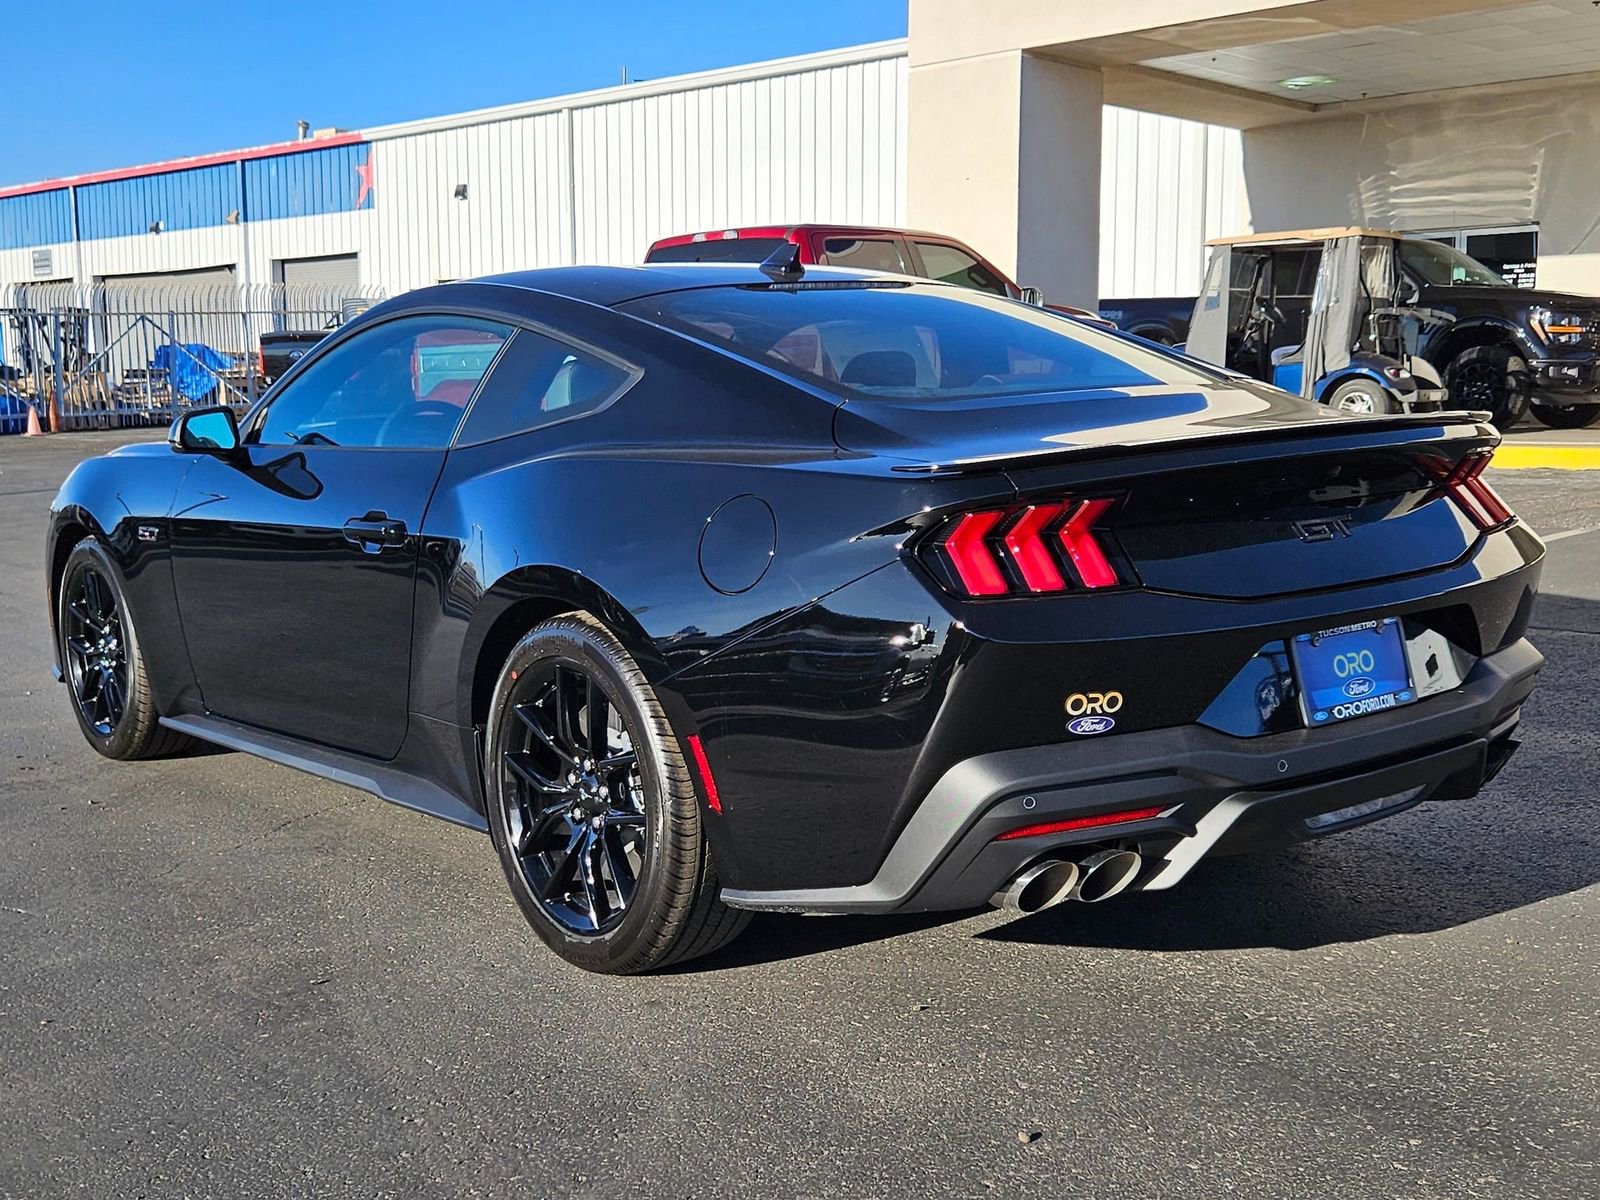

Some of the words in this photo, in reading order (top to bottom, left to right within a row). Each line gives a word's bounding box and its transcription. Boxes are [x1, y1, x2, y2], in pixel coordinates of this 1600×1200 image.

[1291, 514, 1352, 541] GT
[1318, 626, 1350, 638] TUCSON
[1350, 620, 1377, 632] METRO
[1333, 649, 1375, 678] ORO
[1348, 679, 1370, 695] Ford
[1065, 691, 1123, 716] ORO
[1334, 693, 1396, 719] OROFORD.COM
[1075, 718, 1108, 732] Ford
